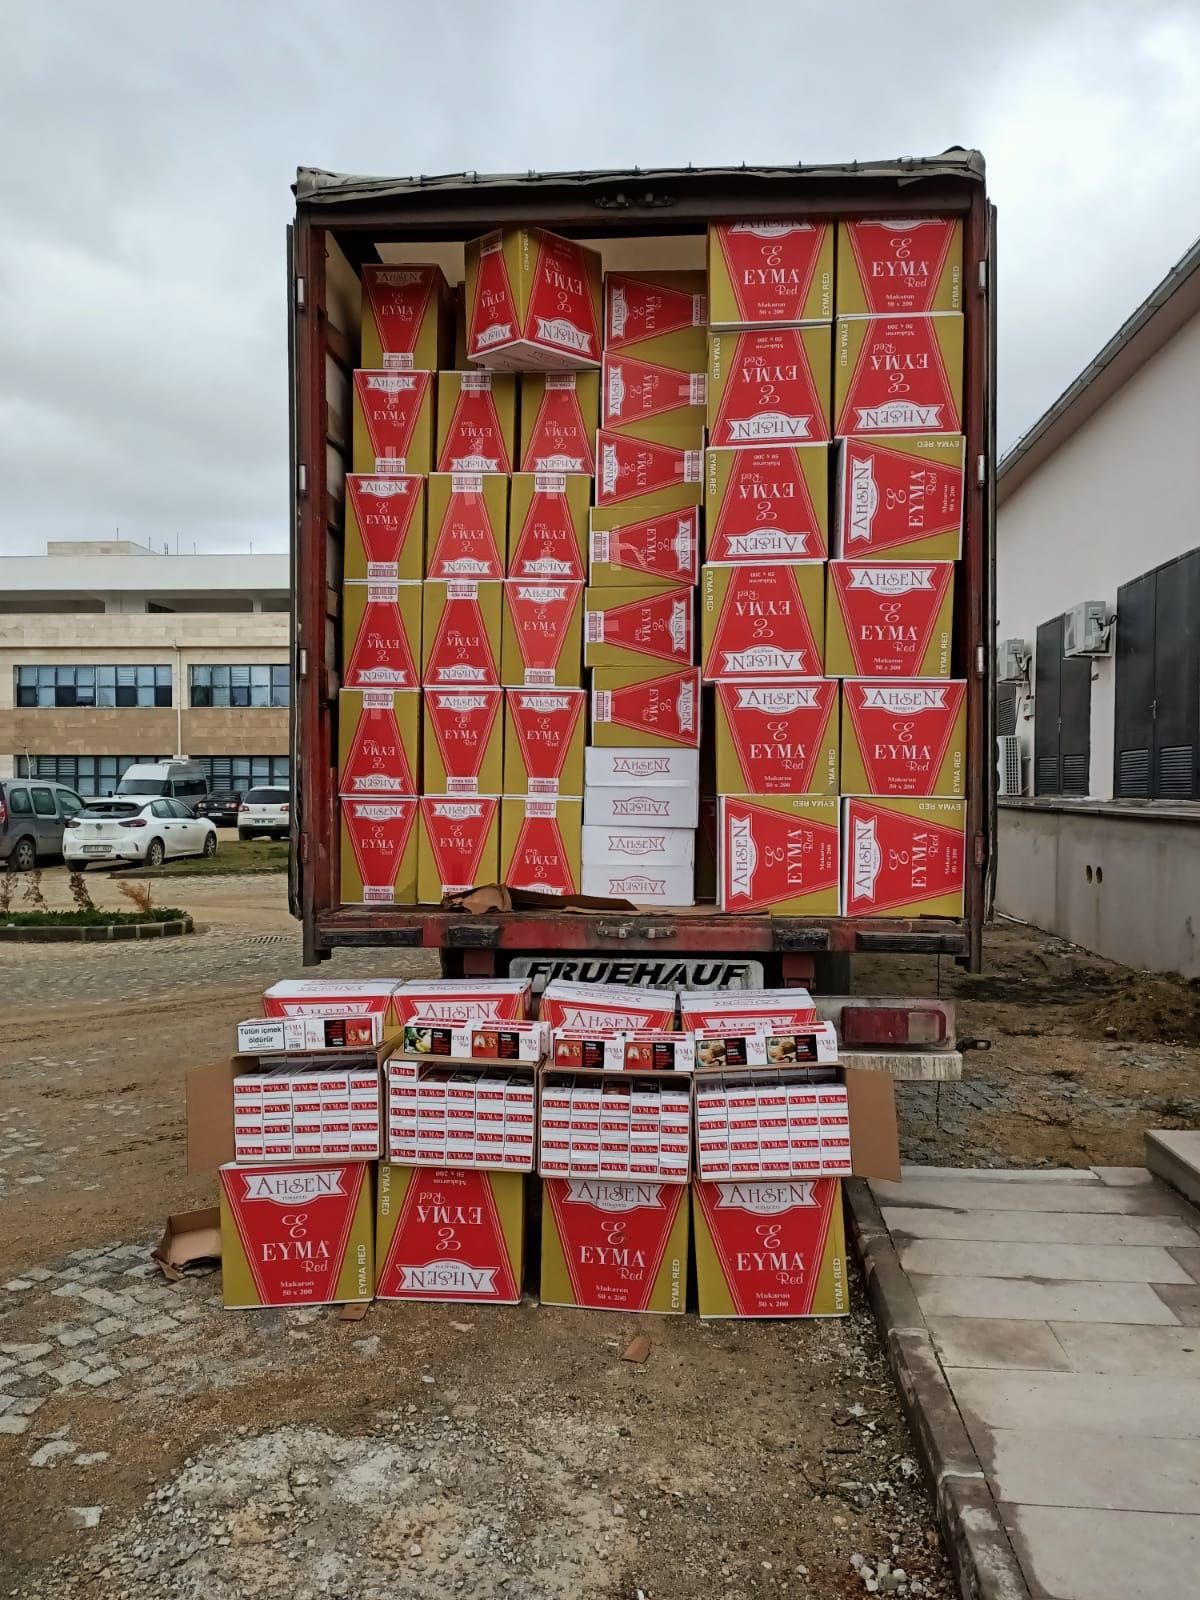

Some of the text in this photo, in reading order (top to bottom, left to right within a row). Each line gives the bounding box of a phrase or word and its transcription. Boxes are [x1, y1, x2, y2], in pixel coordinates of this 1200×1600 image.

[872, 261, 928, 277] EYMA
[545, 268, 582, 296] EYMA
[744, 270, 799, 284] EYMA
[904, 277, 927, 288] Red
[775, 285, 797, 295] Red
[381, 306, 413, 315] EYMA
[646, 296, 655, 329] EYMA
[873, 344, 896, 353] Red
[744, 357, 766, 366] Red
[871, 353, 928, 369] EYMA
[742, 366, 797, 381] EYMA
[643, 375, 652, 407] EYMA
[374, 412, 406, 420] EYMA
[867, 410, 930, 425] AHSEN
[460, 427, 492, 437] EYMA
[545, 427, 577, 436] EYMA
[738, 420, 798, 438] AHSEN
[637, 452, 646, 486] EYMA
[742, 473, 764, 482] Red
[926, 473, 936, 496] Red
[739, 483, 795, 497] EYMA
[853, 470, 868, 530] AHSEN
[909, 470, 924, 527] EYMA
[366, 515, 398, 525] EYMA
[452, 530, 484, 539] EYMA
[736, 537, 797, 552] AHSEN
[859, 571, 925, 586] AHSEN
[738, 591, 760, 600] Red
[736, 601, 790, 616] EYMA
[524, 622, 556, 630] EYMA
[642, 609, 651, 642] EYMA
[860, 626, 917, 641] EYMA
[447, 637, 479, 646] EYMA
[893, 642, 915, 652] Red
[732, 654, 794, 669] AHSEN
[747, 690, 809, 704] AHSEN
[872, 690, 937, 705] AHSEN
[649, 688, 658, 722] EYMA
[445, 730, 478, 739] EYMA
[527, 731, 559, 740] EYMA
[363, 747, 395, 755] EYMA
[750, 744, 805, 759] EYMA
[875, 745, 930, 760] EYMA
[621, 760, 664, 770] AHSEN
[782, 760, 803, 770] Red
[907, 761, 929, 772] Red
[620, 803, 661, 813] AHSEN
[441, 839, 473, 847] EYMA
[616, 839, 658, 849] AHSEN
[803, 831, 813, 854] Red
[928, 835, 938, 858] Red
[524, 856, 557, 864] EYMA
[733, 824, 748, 887] AHSEN
[788, 830, 802, 884] EYMA
[856, 827, 871, 889] AHSEN
[912, 833, 927, 888] EYMA
[616, 882, 657, 892] AHSEN
[527, 962, 748, 985] FRUEHAUF
[426, 1004, 489, 1019] AHSEN
[257, 1175, 333, 1194] AHSEN
[382, 1167, 390, 1193] EYMA
[419, 1192, 445, 1205] Red
[577, 1183, 651, 1202] AHSEN
[730, 1184, 805, 1203] AHSEN
[417, 1206, 481, 1224] EYMA
[261, 1240, 330, 1262] EYMA
[580, 1246, 645, 1267] EYMA
[301, 1261, 327, 1273] Red
[737, 1252, 804, 1271] EYMA
[358, 1245, 367, 1295] EYMA RED
[617, 1267, 643, 1280] Red
[411, 1271, 483, 1289] AHSEN
[776, 1272, 803, 1285] Red
